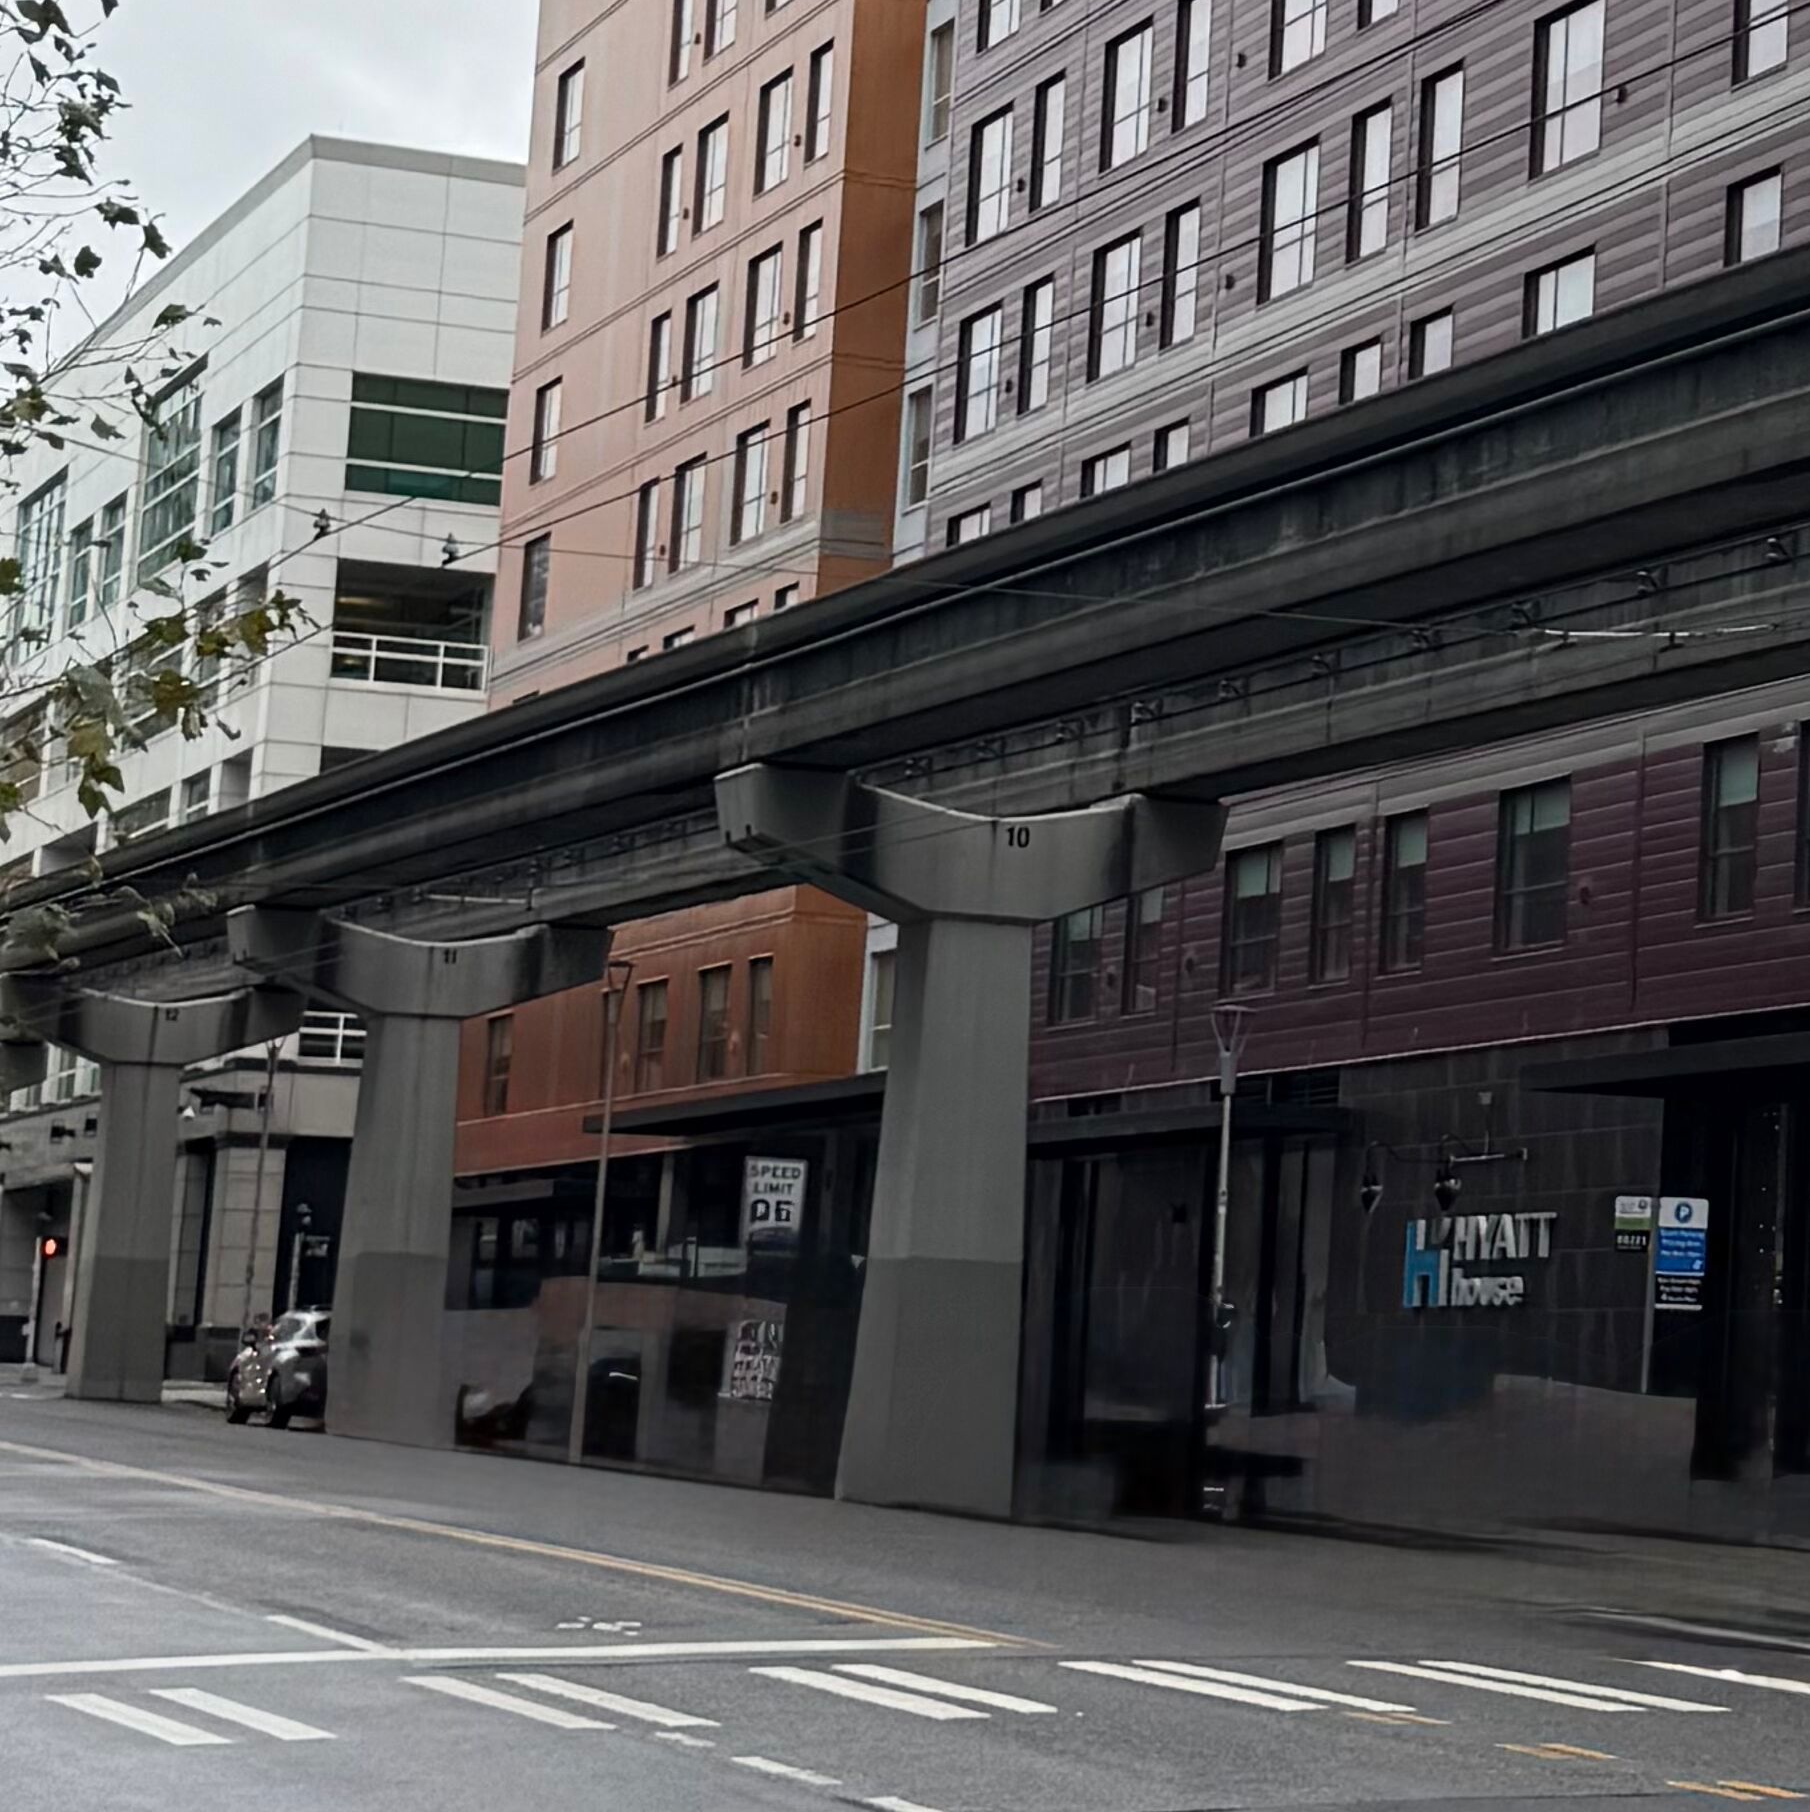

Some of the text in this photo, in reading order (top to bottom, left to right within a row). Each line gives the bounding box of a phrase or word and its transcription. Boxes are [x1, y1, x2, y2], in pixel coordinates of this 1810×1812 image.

[1006, 826, 1030, 848] 10
[444, 948, 457, 965] 11
[165, 1008, 180, 1022] 12
[749, 1164, 802, 1179] SPEED
[752, 1182, 794, 1195] LIMIT
[1453, 1212, 1557, 1260] HYATT
[1451, 1267, 1524, 1306] house
